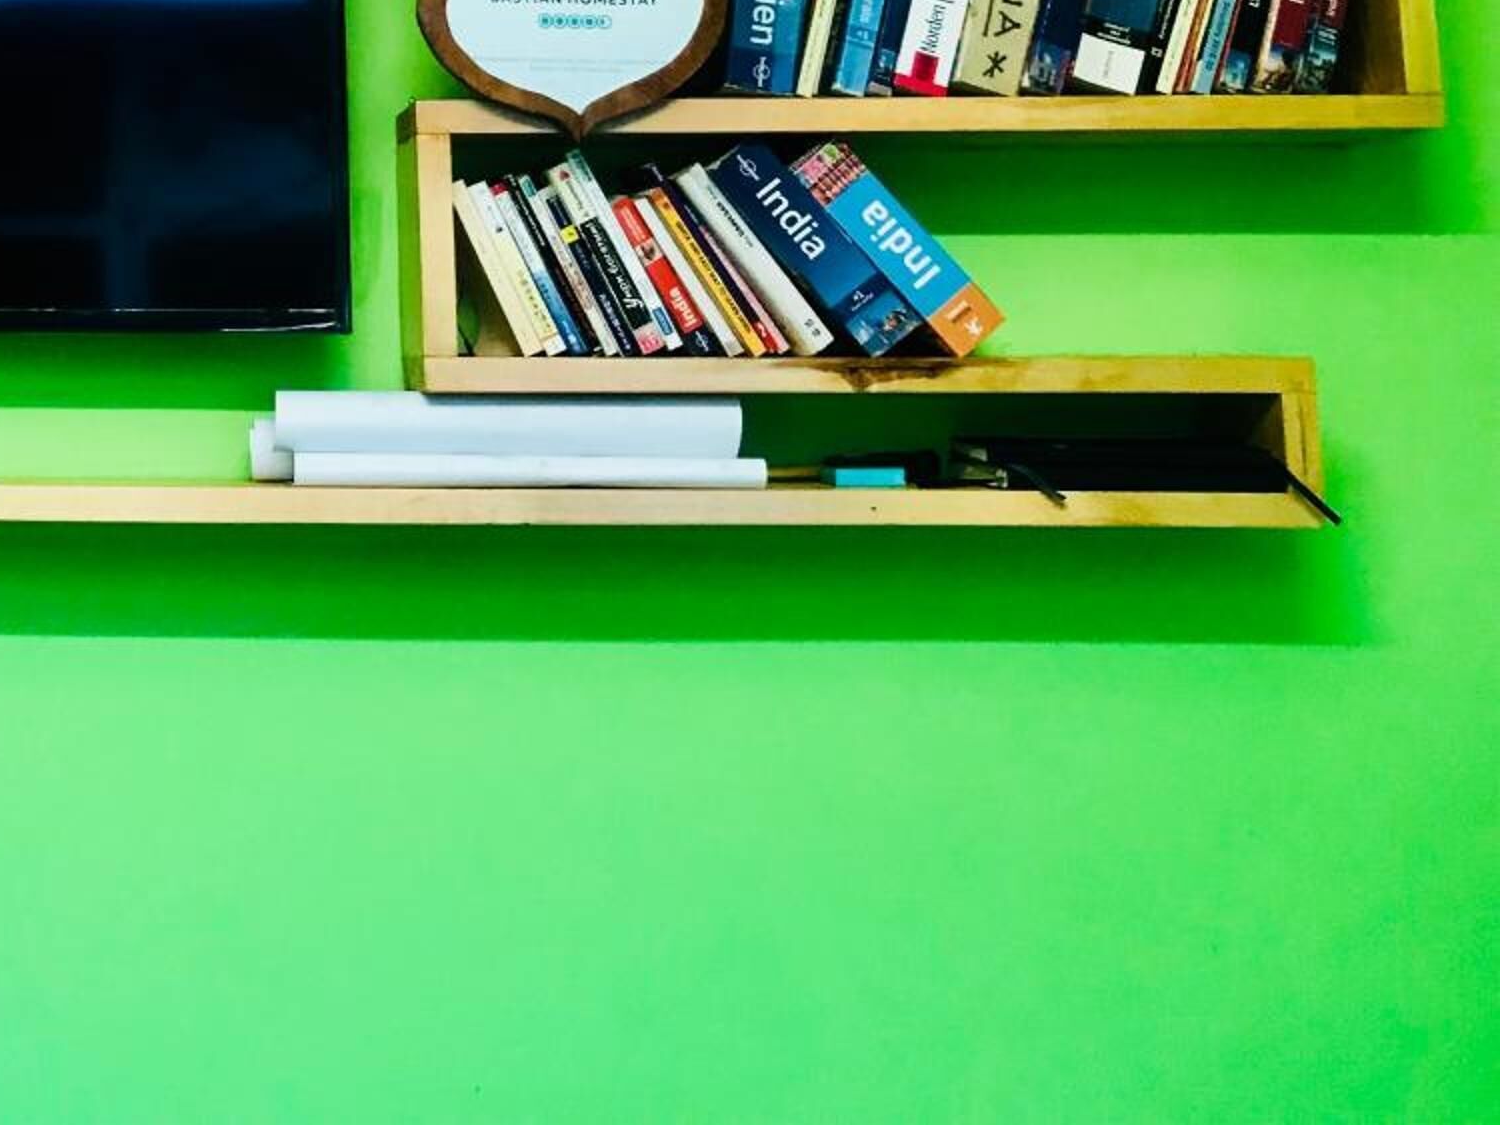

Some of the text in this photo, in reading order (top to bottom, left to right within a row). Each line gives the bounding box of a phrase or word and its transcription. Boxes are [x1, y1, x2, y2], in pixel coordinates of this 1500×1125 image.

[921, 3, 946, 54] Norden
[755, 178, 825, 261] India
[862, 200, 941, 290] India
[669, 287, 696, 326] India
